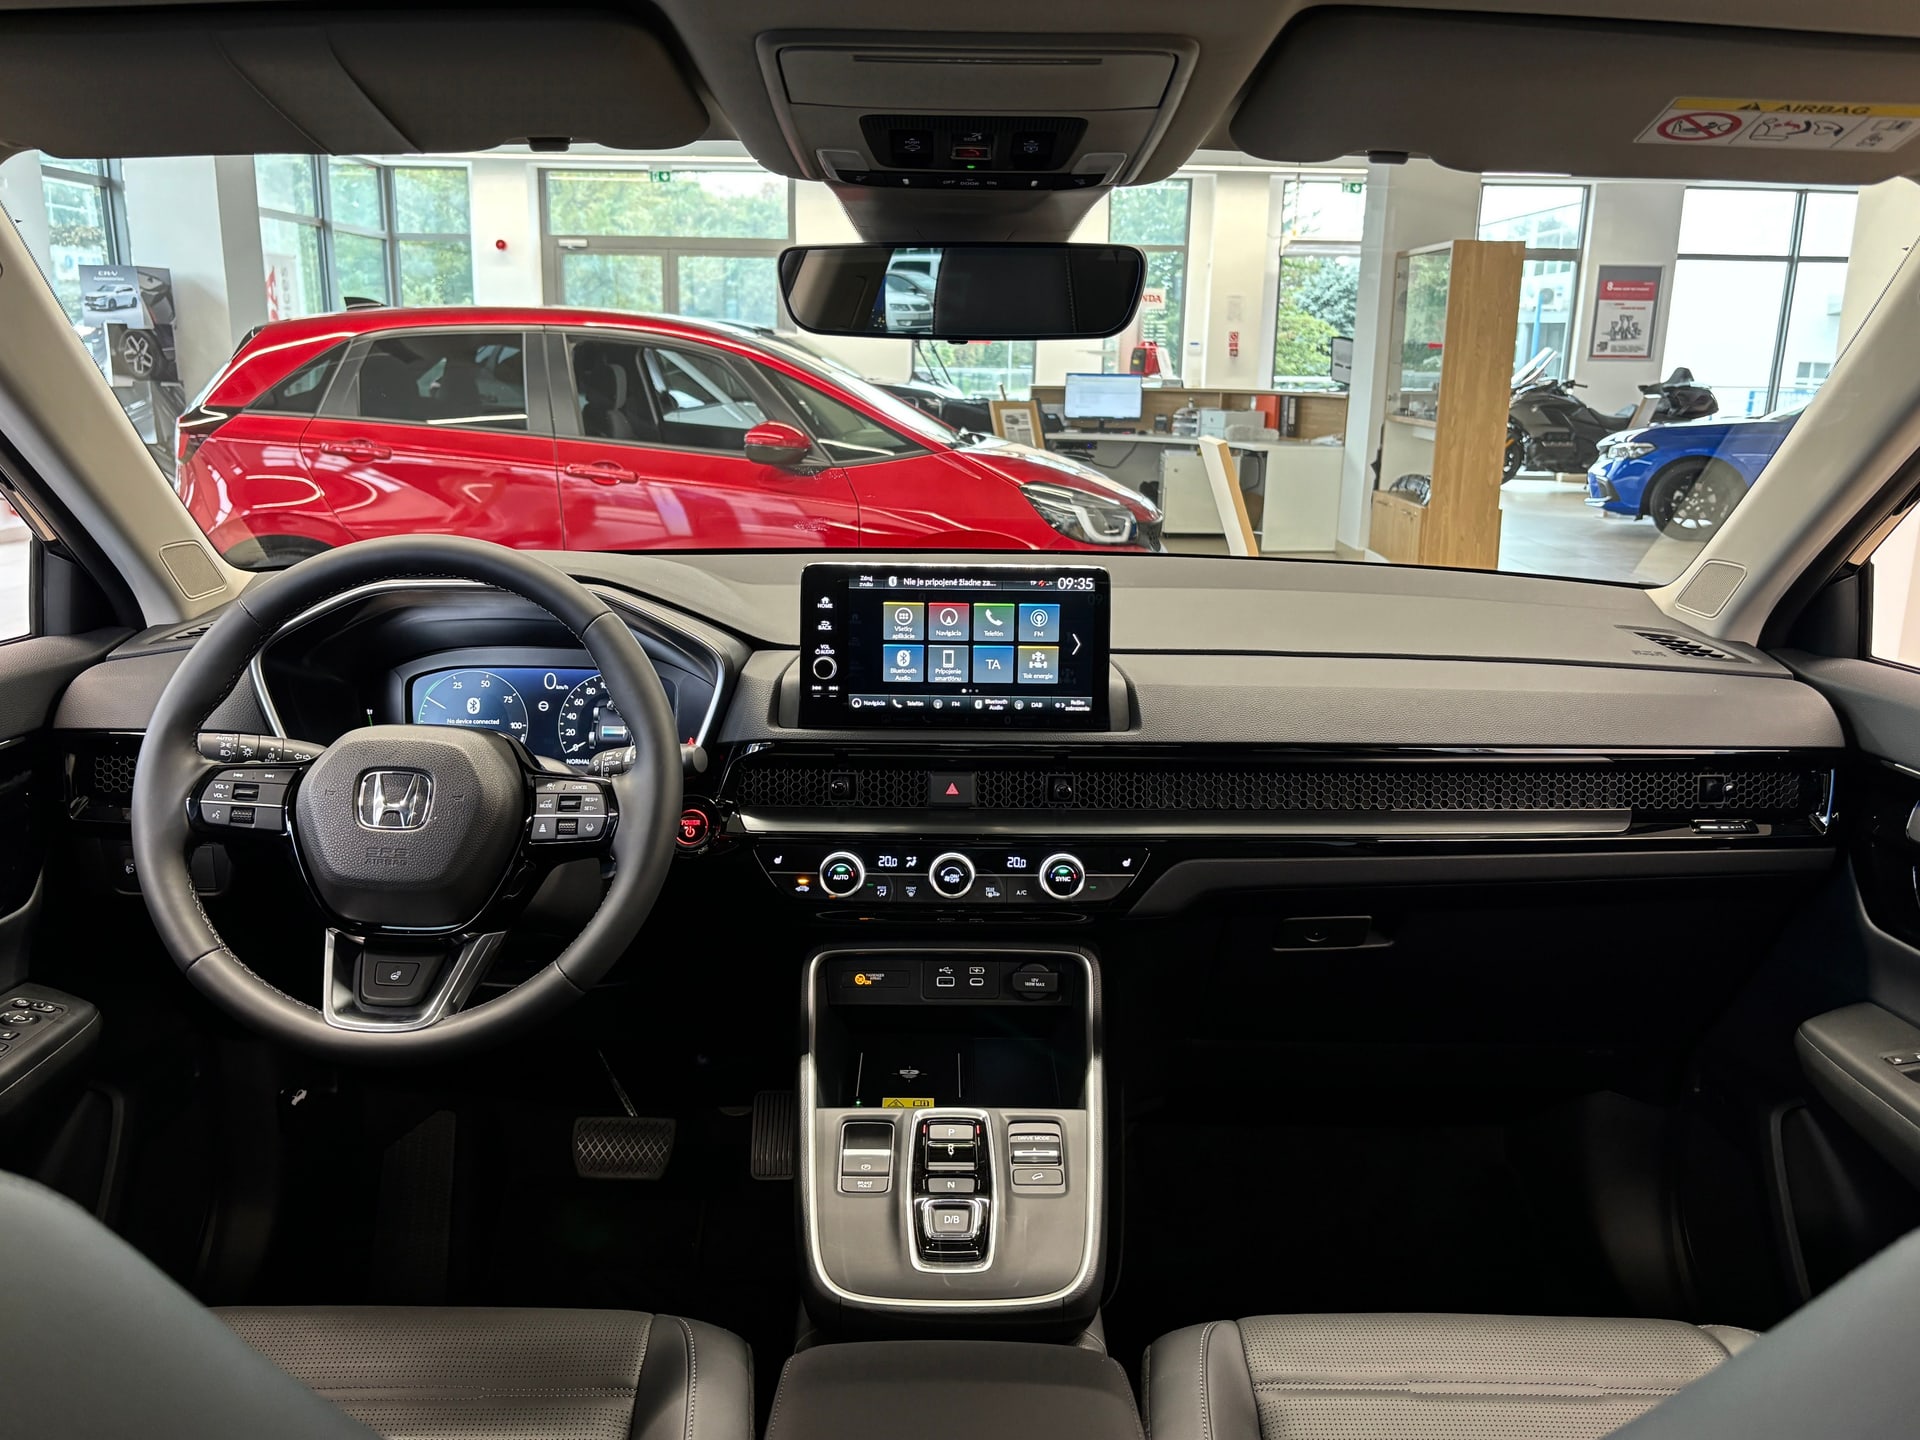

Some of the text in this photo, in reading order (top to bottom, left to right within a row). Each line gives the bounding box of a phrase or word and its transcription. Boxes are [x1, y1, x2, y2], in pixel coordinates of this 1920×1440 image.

[1775, 104, 1870, 116] AIRBAG
[1142, 294, 1163, 304] NDA
[903, 578, 915, 586] Nie
[916, 578, 924, 587] je
[925, 577, 958, 588] pripojené
[1057, 577, 1094, 590] 09:35
[985, 659, 1001, 670] TA
[481, 680, 490, 688] 50
[544, 672, 557, 690] 0
[586, 687, 596, 695] 80
[574, 698, 584, 706] 60
[566, 712, 577, 720] 40
[565, 728, 576, 736] 20
[877, 855, 898, 867] 20.0
[1006, 856, 1027, 868] 20.0
[947, 1128, 956, 1137] P
[943, 1215, 961, 1224] D/B
